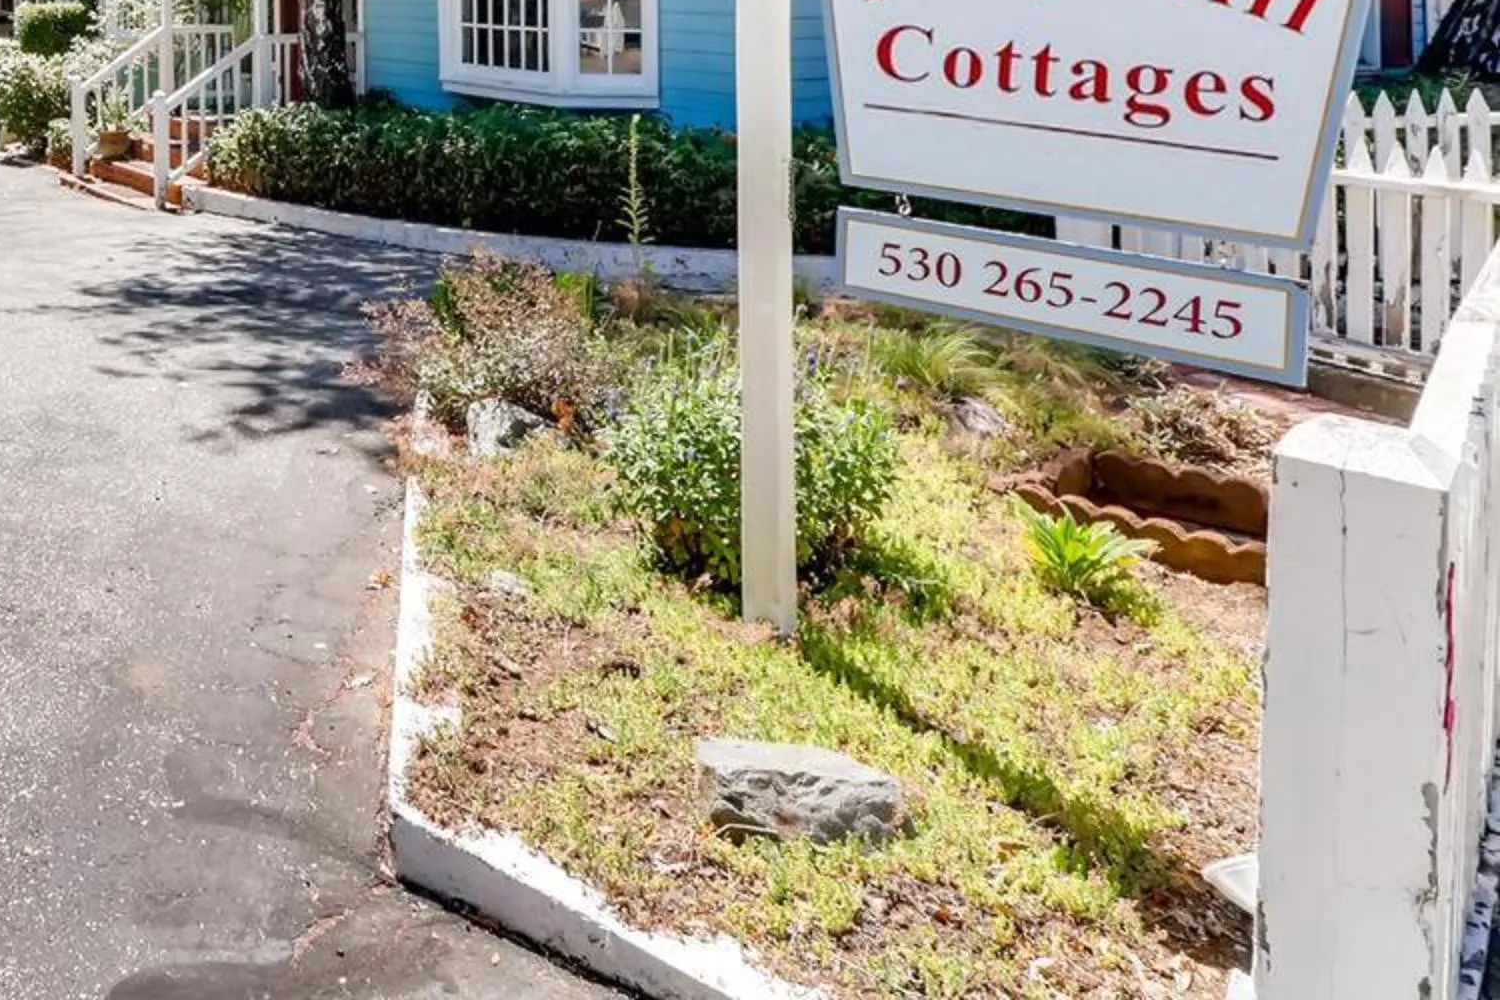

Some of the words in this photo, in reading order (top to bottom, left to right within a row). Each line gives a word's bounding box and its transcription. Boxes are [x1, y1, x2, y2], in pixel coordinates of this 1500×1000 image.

[875, 24, 1277, 129] Cottages
[878, 242, 962, 288] 530
[983, 260, 1244, 340] 265-2245
